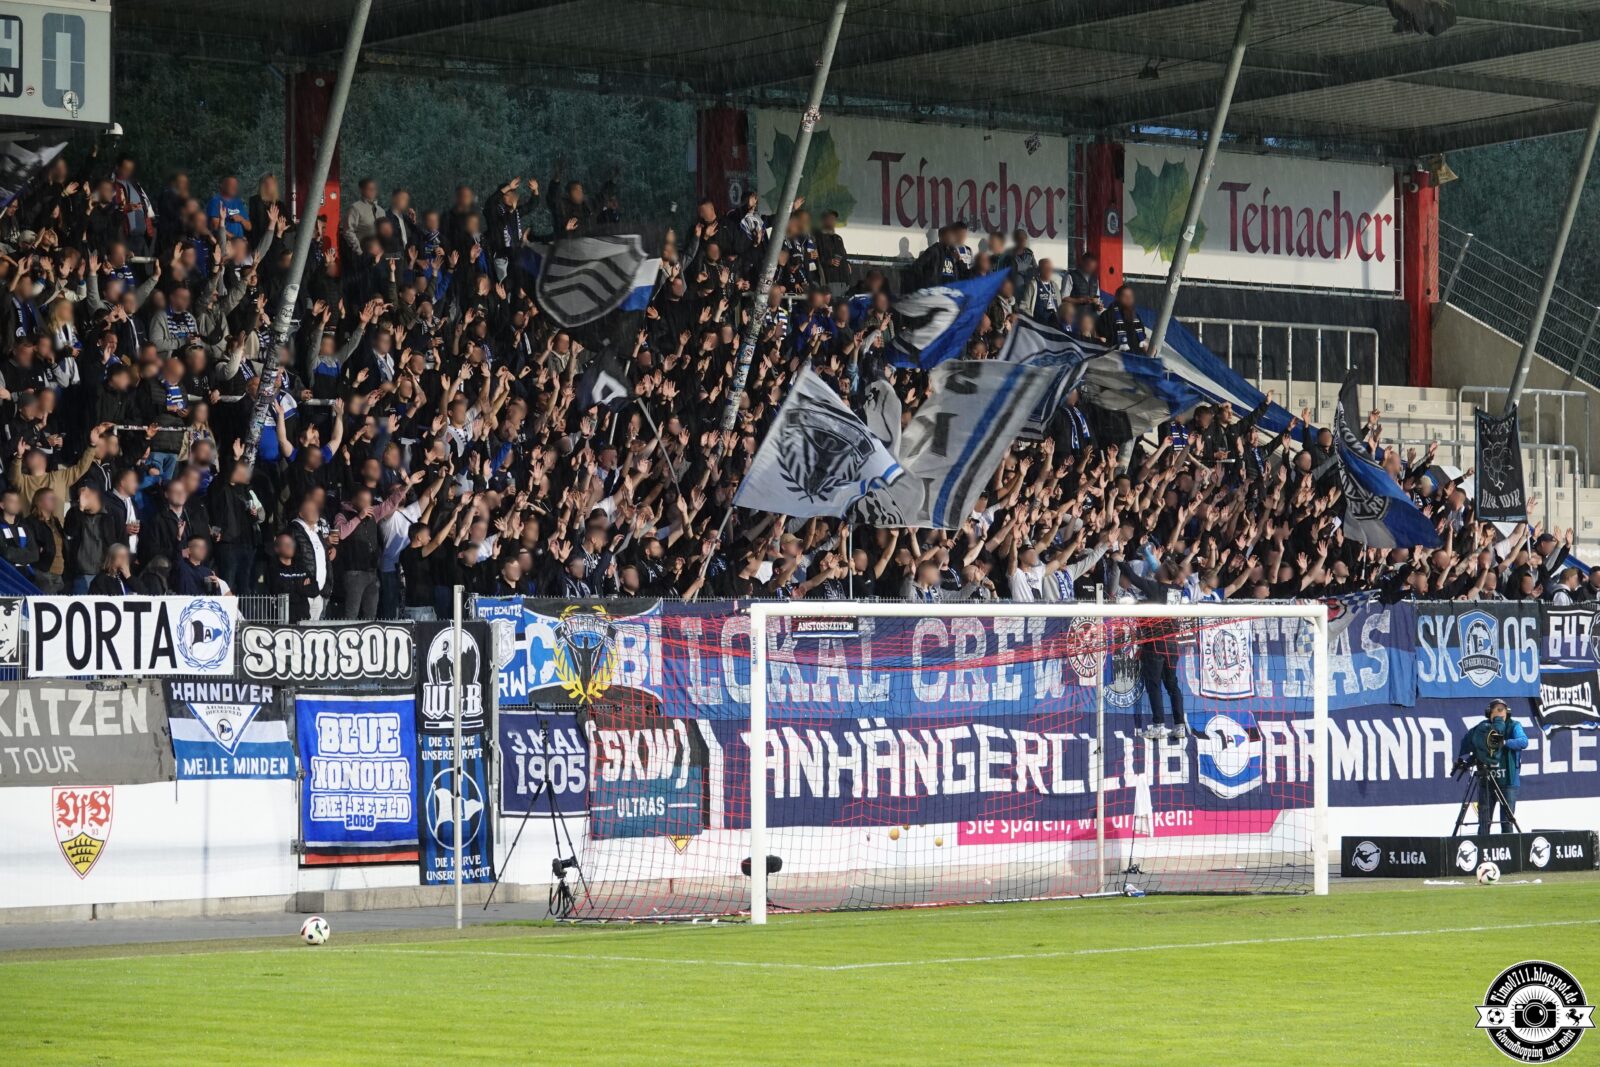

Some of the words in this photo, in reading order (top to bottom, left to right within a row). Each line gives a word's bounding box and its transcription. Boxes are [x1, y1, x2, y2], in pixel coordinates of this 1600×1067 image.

[867, 150, 1066, 239] Teinacher
[1217, 181, 1392, 263] Teinacher
[34, 601, 178, 671] PORTA
[1417, 615, 1459, 683] SK
[1503, 617, 1539, 684] 05
[1549, 616, 1593, 657] 647
[243, 627, 411, 679] SAMSON
[912, 616, 1066, 702] CREW
[171, 682, 273, 703] HANNOVER
[424, 685, 482, 717] WB
[319, 716, 398, 753] BLUE
[428, 736, 442, 747] DIE
[4, 746, 79, 774] TOUR
[184, 757, 228, 775] MELLE
[233, 757, 289, 775] MINDEN
[422, 750, 454, 760] UNSERE
[313, 759, 409, 790] HONOUR
[515, 755, 587, 795] 1905
[313, 795, 409, 819] BIELEFELD
[346, 814, 375, 828] 2008
[617, 797, 665, 817] ULTRAS
[435, 857, 448, 868] DIE
[1389, 851, 1399, 865] 3.
[1556, 846, 1564, 859] 3.
